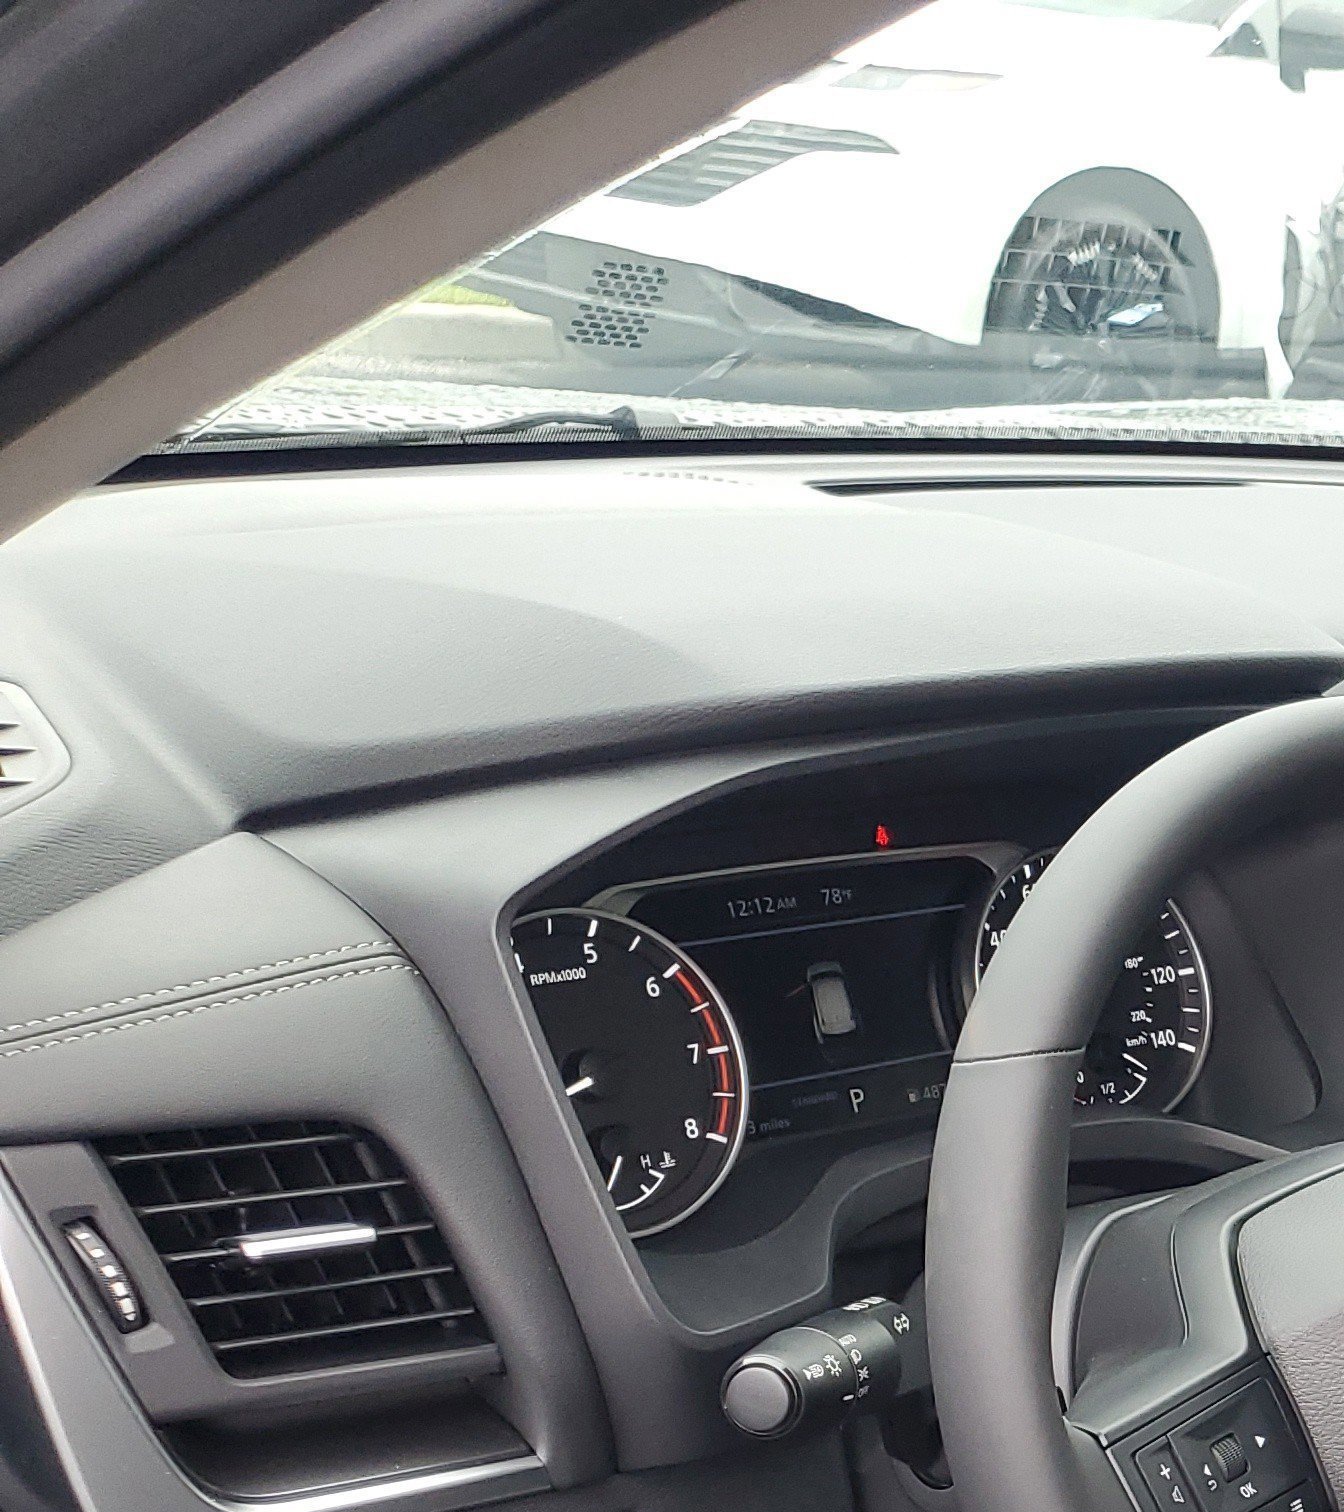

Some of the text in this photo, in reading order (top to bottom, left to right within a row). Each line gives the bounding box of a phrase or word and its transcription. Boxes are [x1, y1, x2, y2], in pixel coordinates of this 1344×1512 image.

[583, 942, 598, 964] 5
[530, 966, 587, 986] RPMx1000
[1150, 966, 1176, 985] 120
[645, 976, 660, 998] 6
[1130, 1010, 1146, 1022] 220
[1126, 1035, 1147, 1047] km/h
[1150, 1029, 1176, 1048] 140
[686, 1042, 700, 1064] 7
[1100, 1083, 1116, 1095] 1/2
[848, 1088, 865, 1113] P
[684, 1118, 700, 1139] 8
[759, 1118, 791, 1132] miles
[640, 1154, 651, 1170] H
[1239, 1481, 1258, 1498] OK
